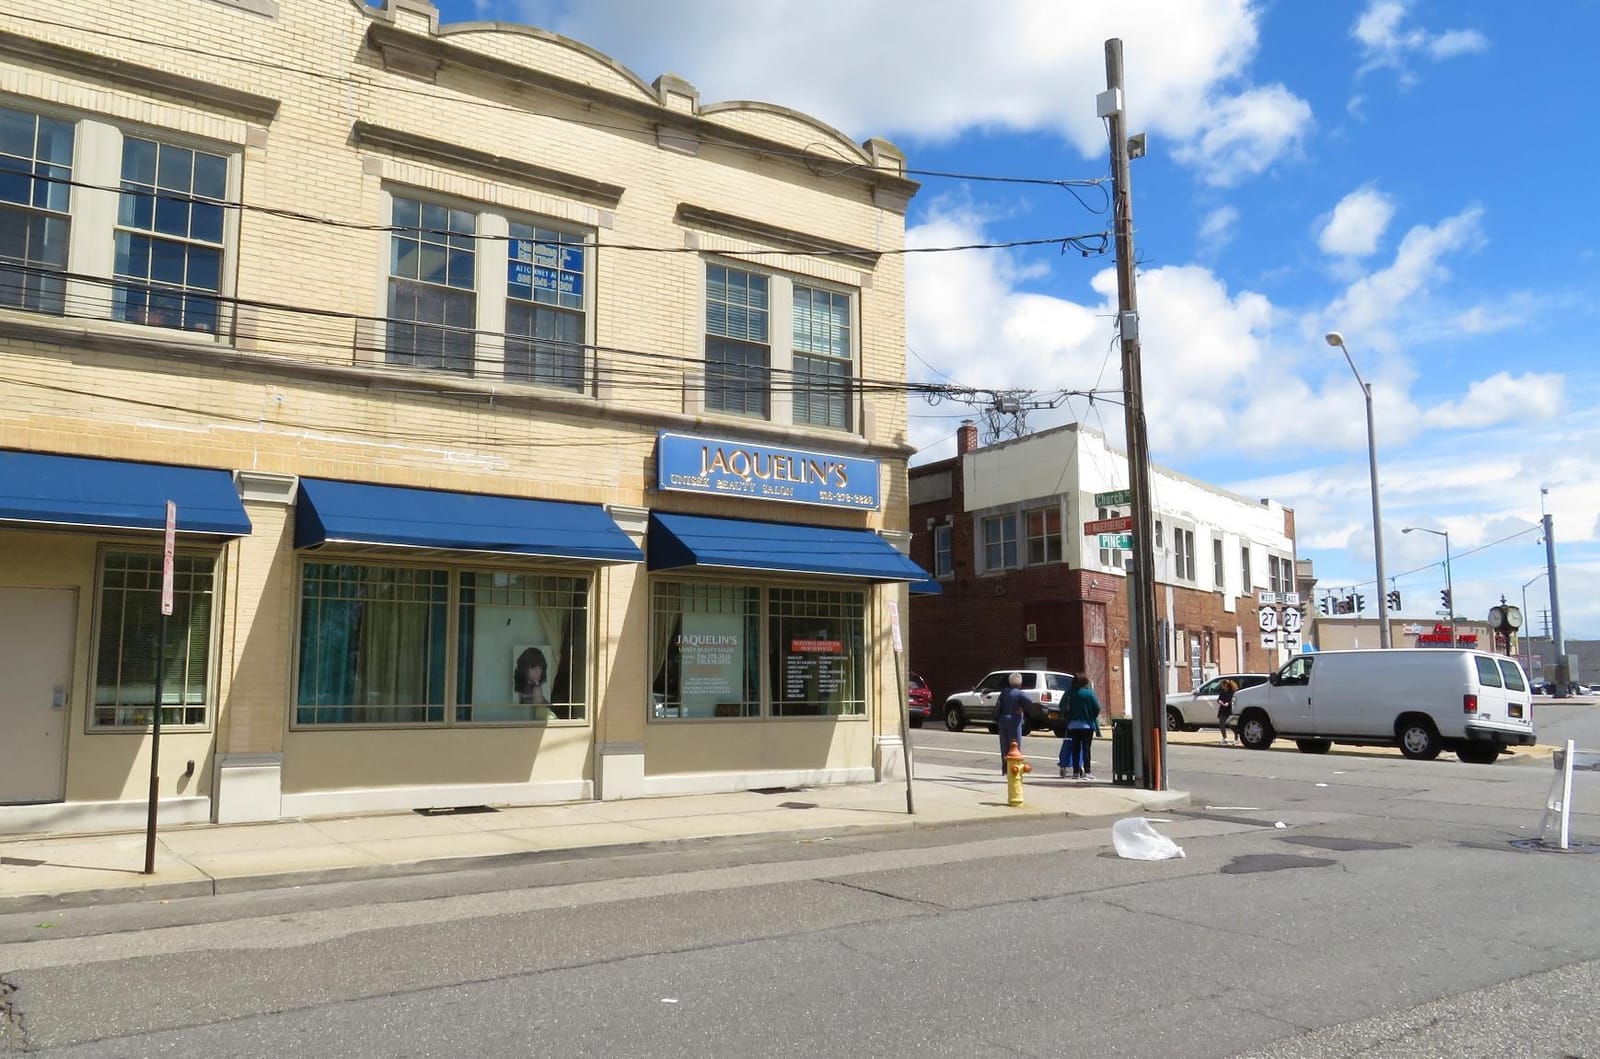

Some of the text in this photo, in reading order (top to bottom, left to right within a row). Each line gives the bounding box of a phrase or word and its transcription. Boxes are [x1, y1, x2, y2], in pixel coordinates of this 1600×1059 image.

[561, 273, 574, 282] LAW
[699, 445, 848, 488] JAQUELIN'S
[671, 474, 794, 496] UNISEX BEAUTY SALON
[1096, 492, 1124, 505] Church
[1102, 535, 1121, 548] PINE
[1284, 594, 1296, 602] EAST
[1262, 612, 1275, 626] 27
[1284, 613, 1298, 627] 27
[676, 634, 737, 646] JAQUELIN'S
